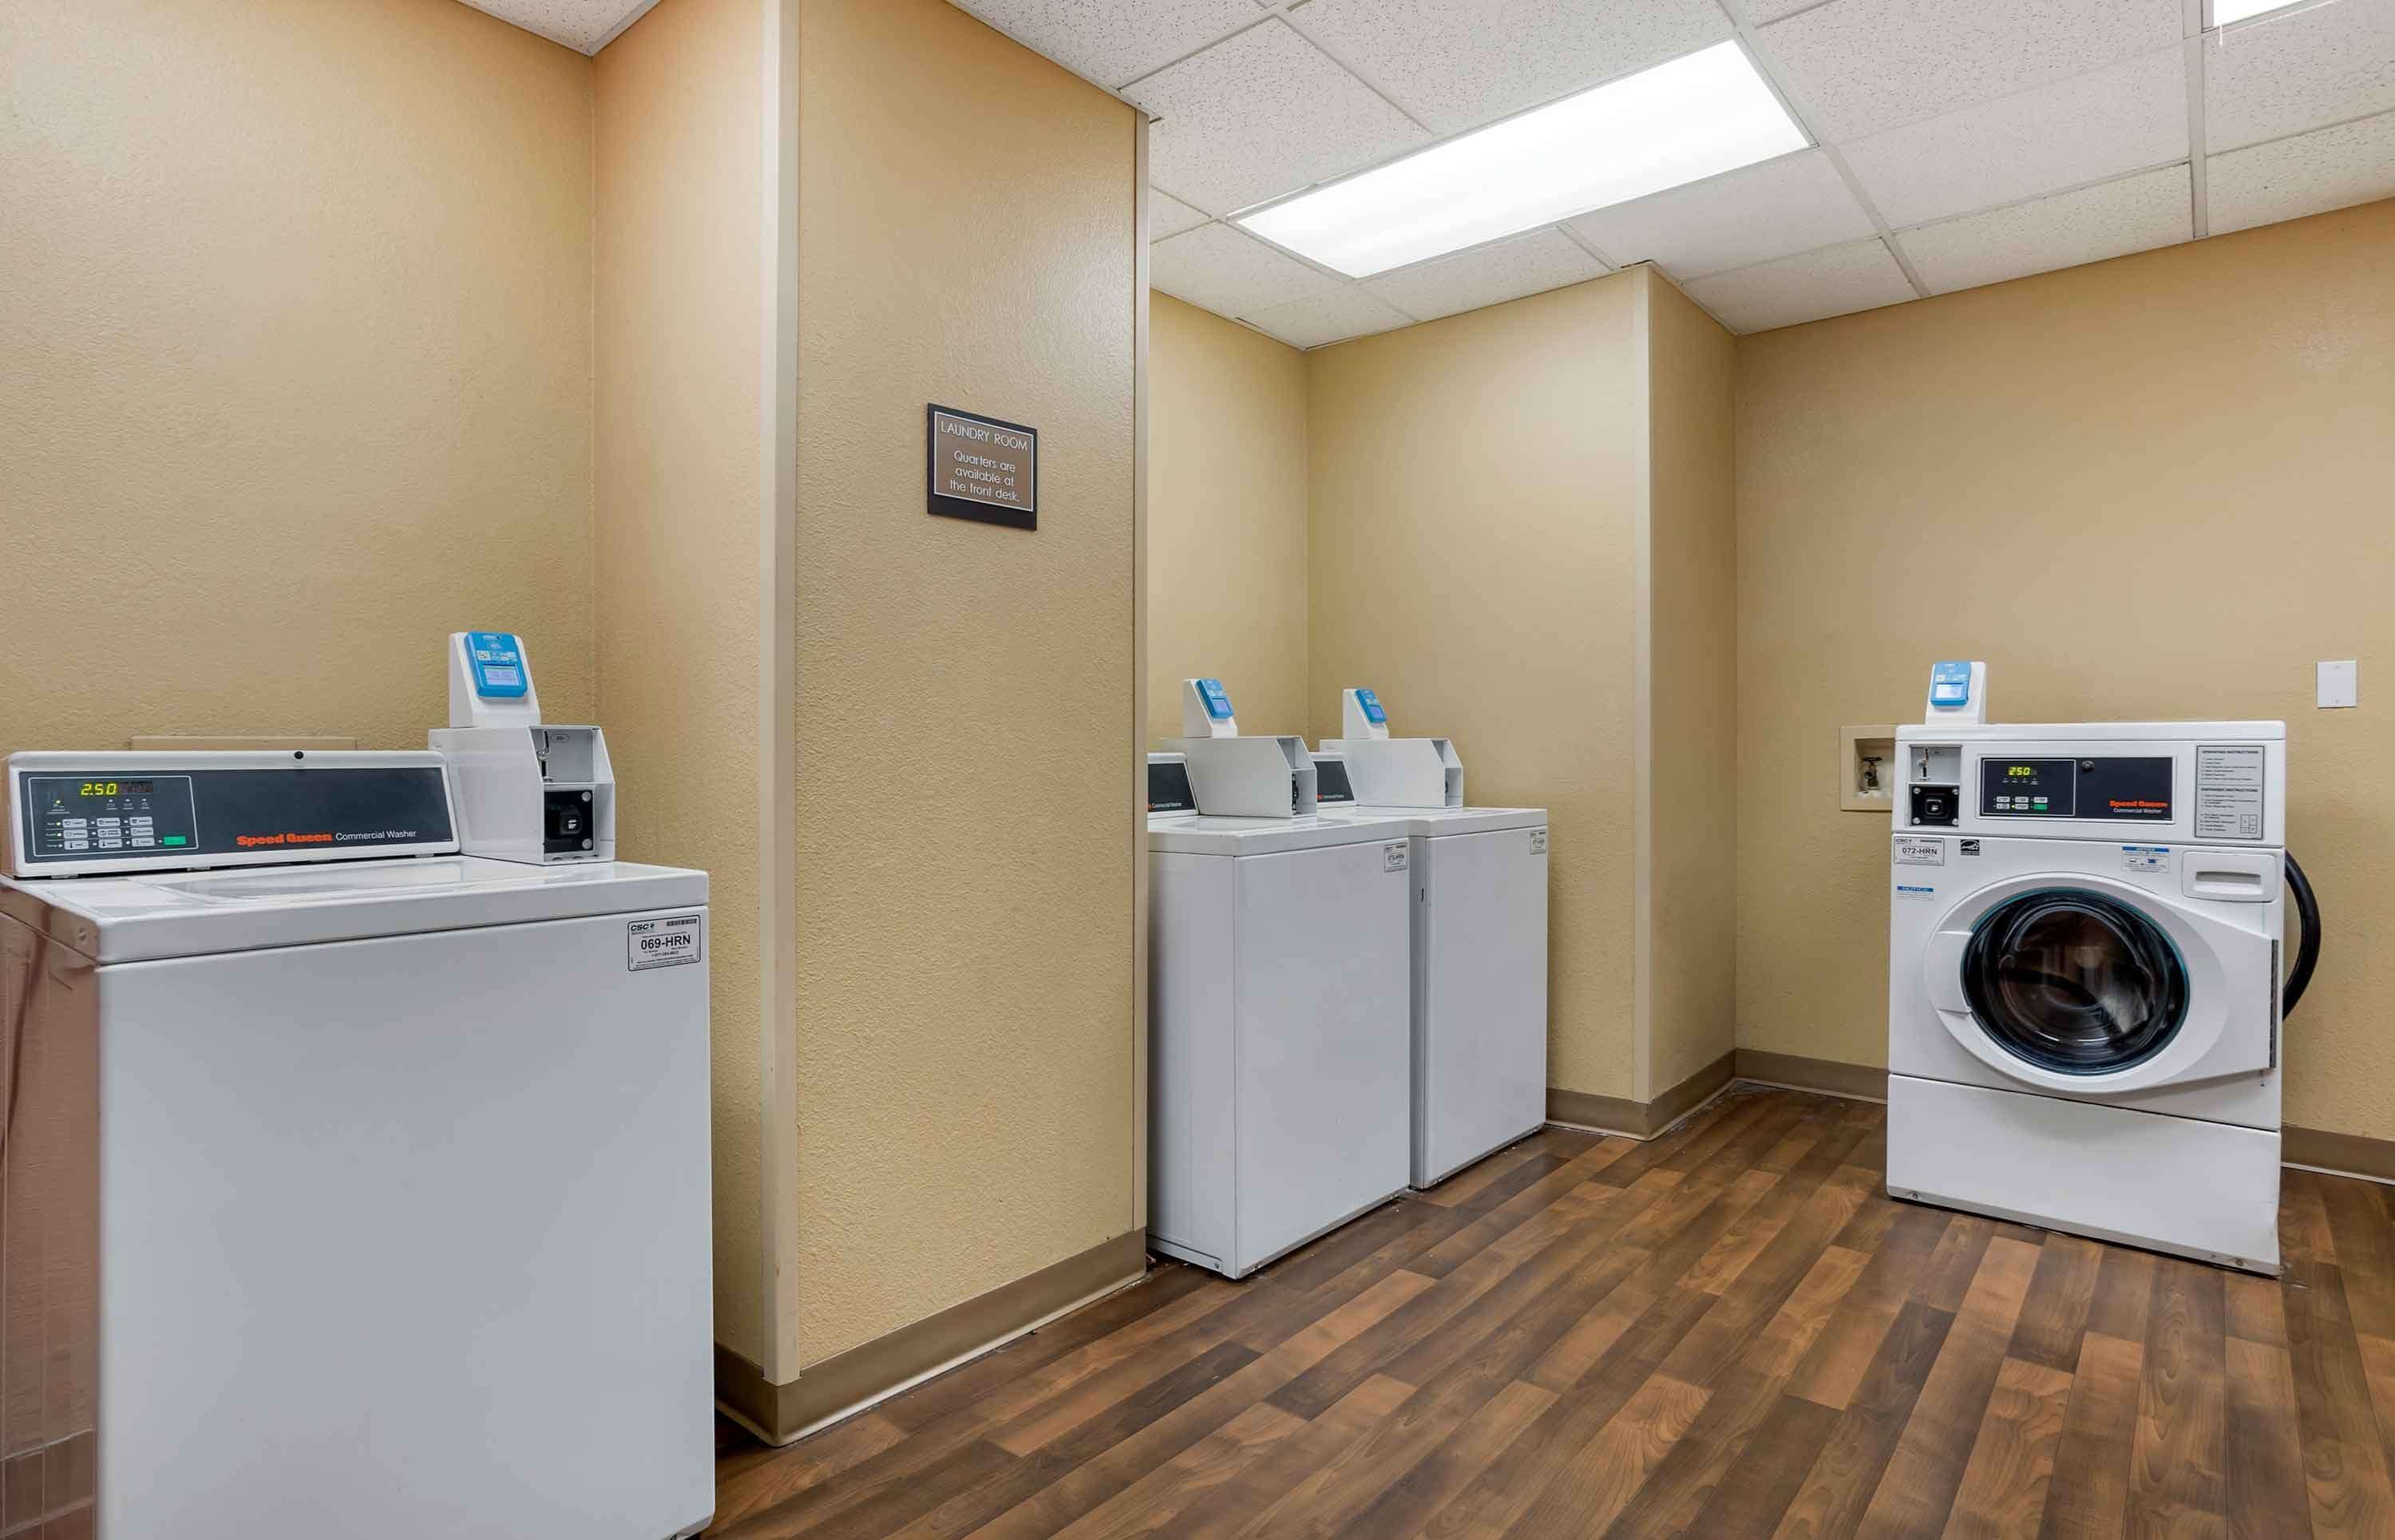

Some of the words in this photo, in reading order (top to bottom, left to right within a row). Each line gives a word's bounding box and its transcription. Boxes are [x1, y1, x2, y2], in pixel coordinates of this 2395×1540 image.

[940, 421, 990, 441] LAUNDRY
[994, 433, 1027, 451] ROOM
[954, 450, 996, 468] Quarters
[1000, 461, 1015, 473] are
[956, 467, 1000, 484] available
[1004, 477, 1015, 486] at
[950, 479, 966, 492] the
[970, 483, 992, 497] front
[996, 489, 1019, 502] desk.
[81, 783, 117, 796] 2.50
[236, 833, 284, 846] Speed
[286, 833, 333, 844] Queen
[335, 830, 385, 841] Commercial
[387, 830, 417, 839] Washer
[1902, 847, 1938, 856] 072-HRN
[641, 934, 691, 950] 069-HRN
